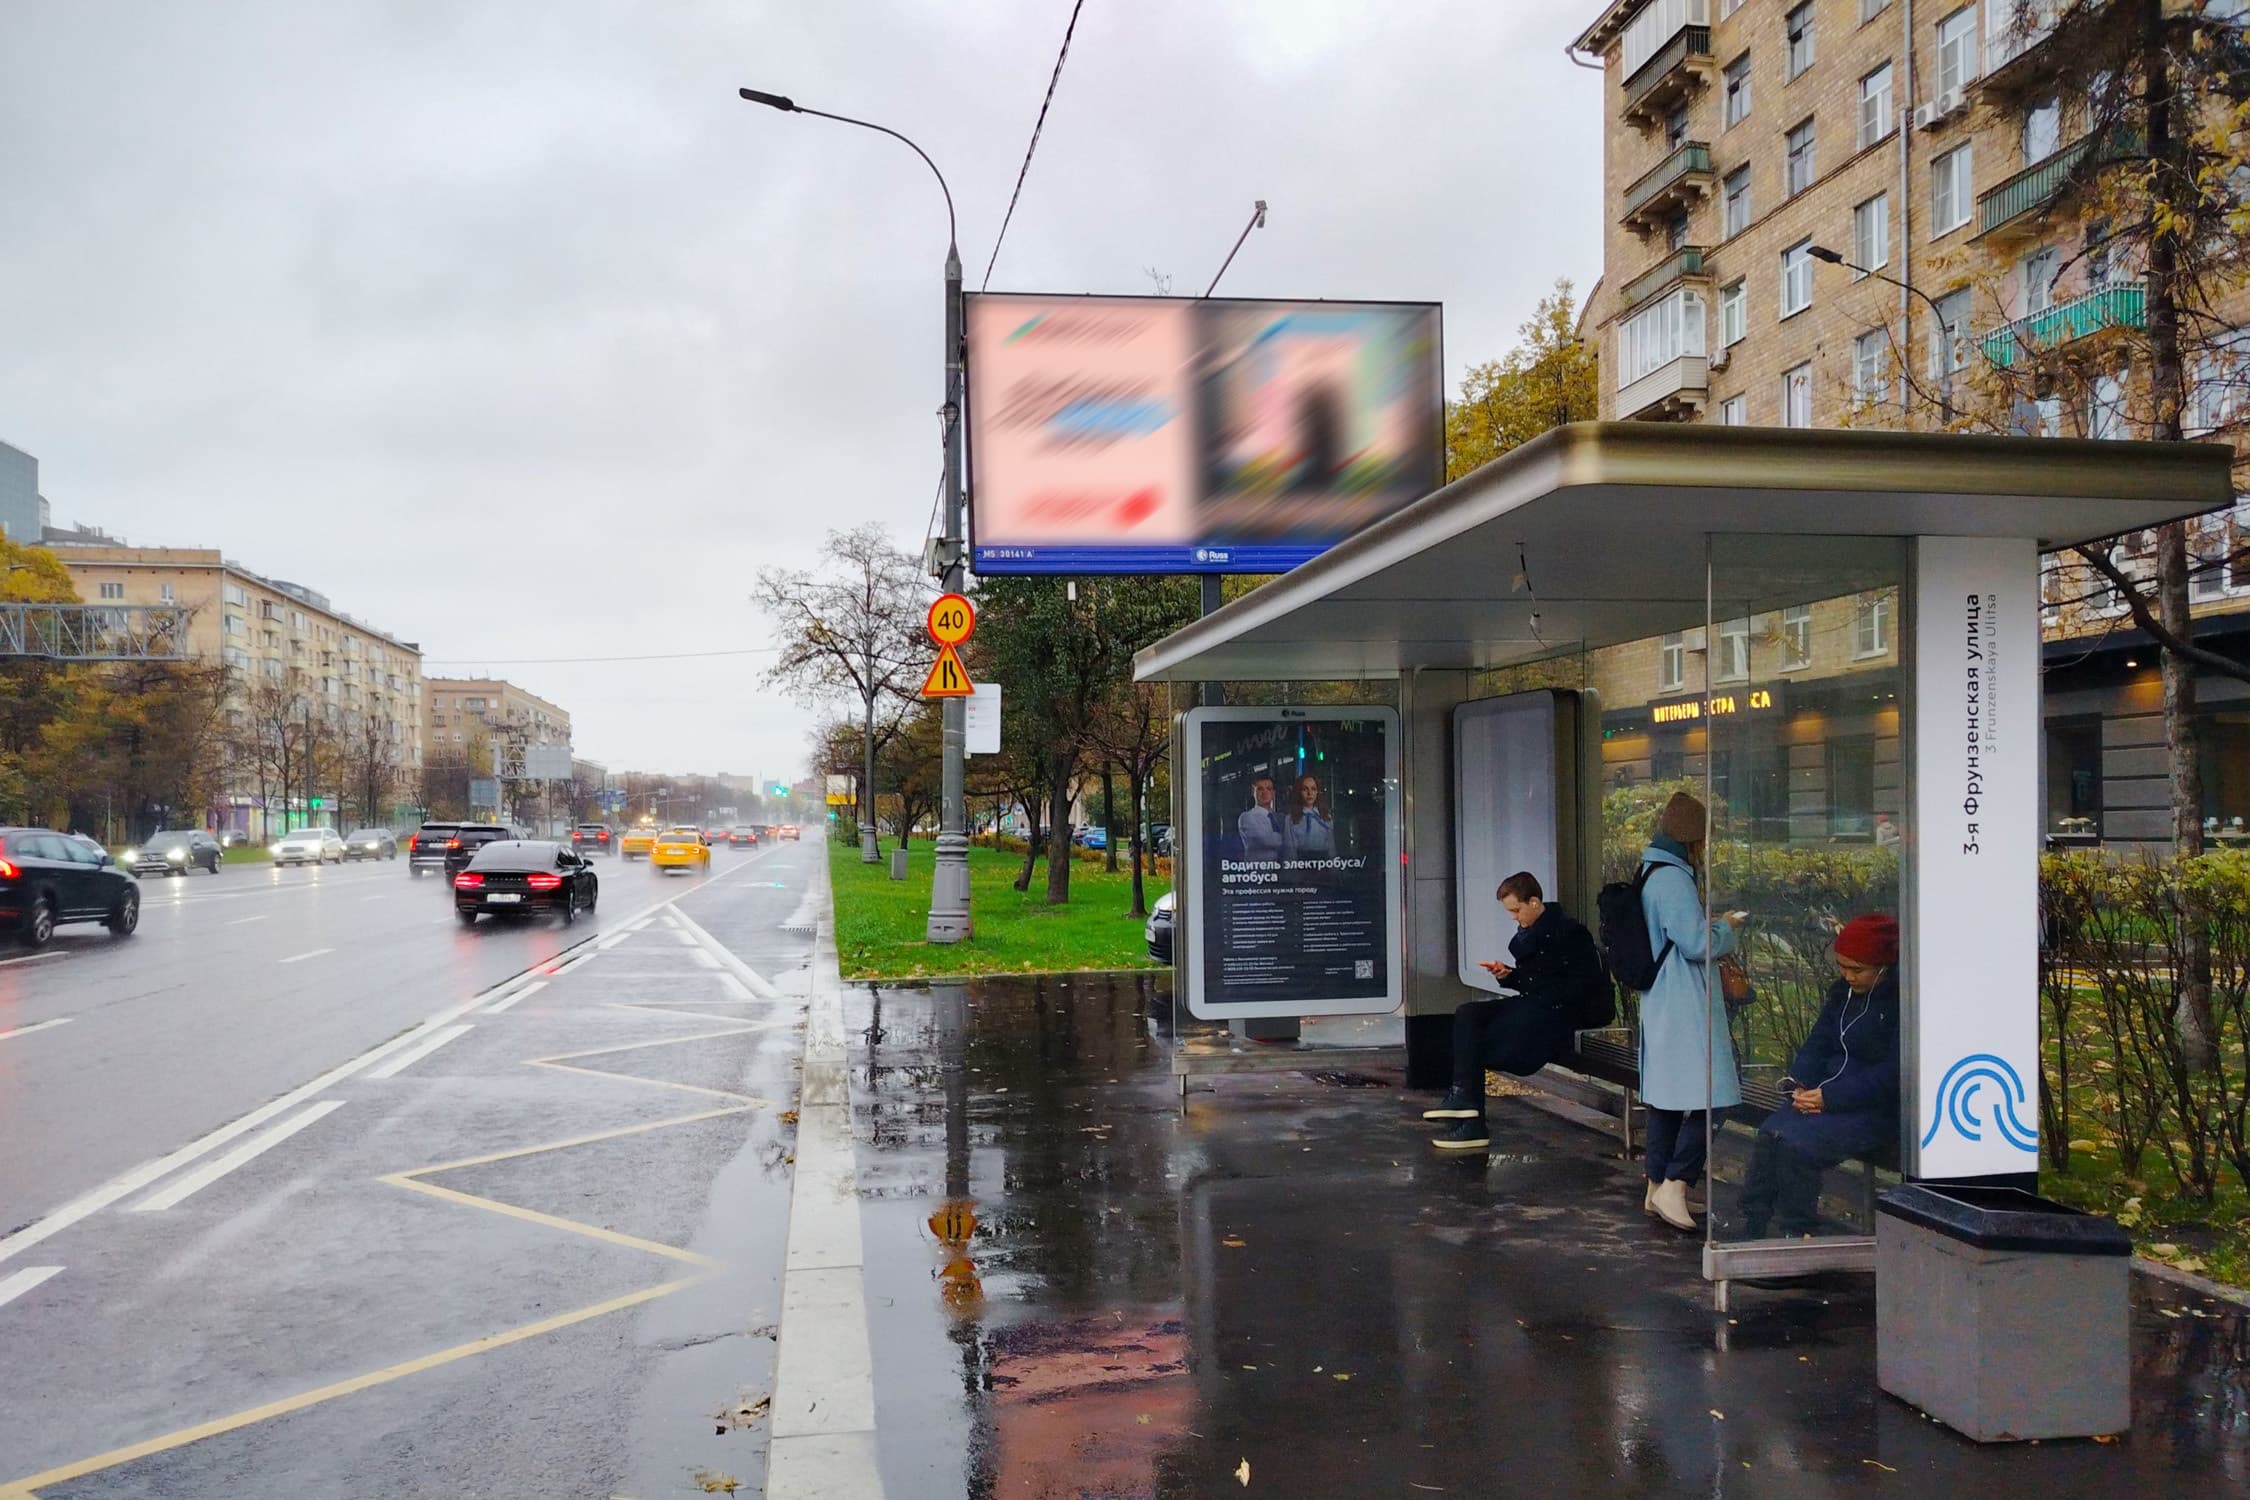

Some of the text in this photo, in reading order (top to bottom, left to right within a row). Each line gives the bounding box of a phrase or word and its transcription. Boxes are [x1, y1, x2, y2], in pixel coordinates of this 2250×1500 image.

[1209, 551, 1229, 560] Russ
[937, 610, 964, 630] 40
[1984, 593, 2001, 753] 3 Frunzenskaya Ulitsa
[1963, 593, 1983, 854] 3-я Фрунзенская улица
[1221, 856, 1367, 873] Водитель электробуса/
[1222, 871, 1278, 885] автобуса
[1222, 888, 1234, 896] Эта
[1235, 888, 1271, 896] профессия
[1294, 887, 1318, 895] городу
